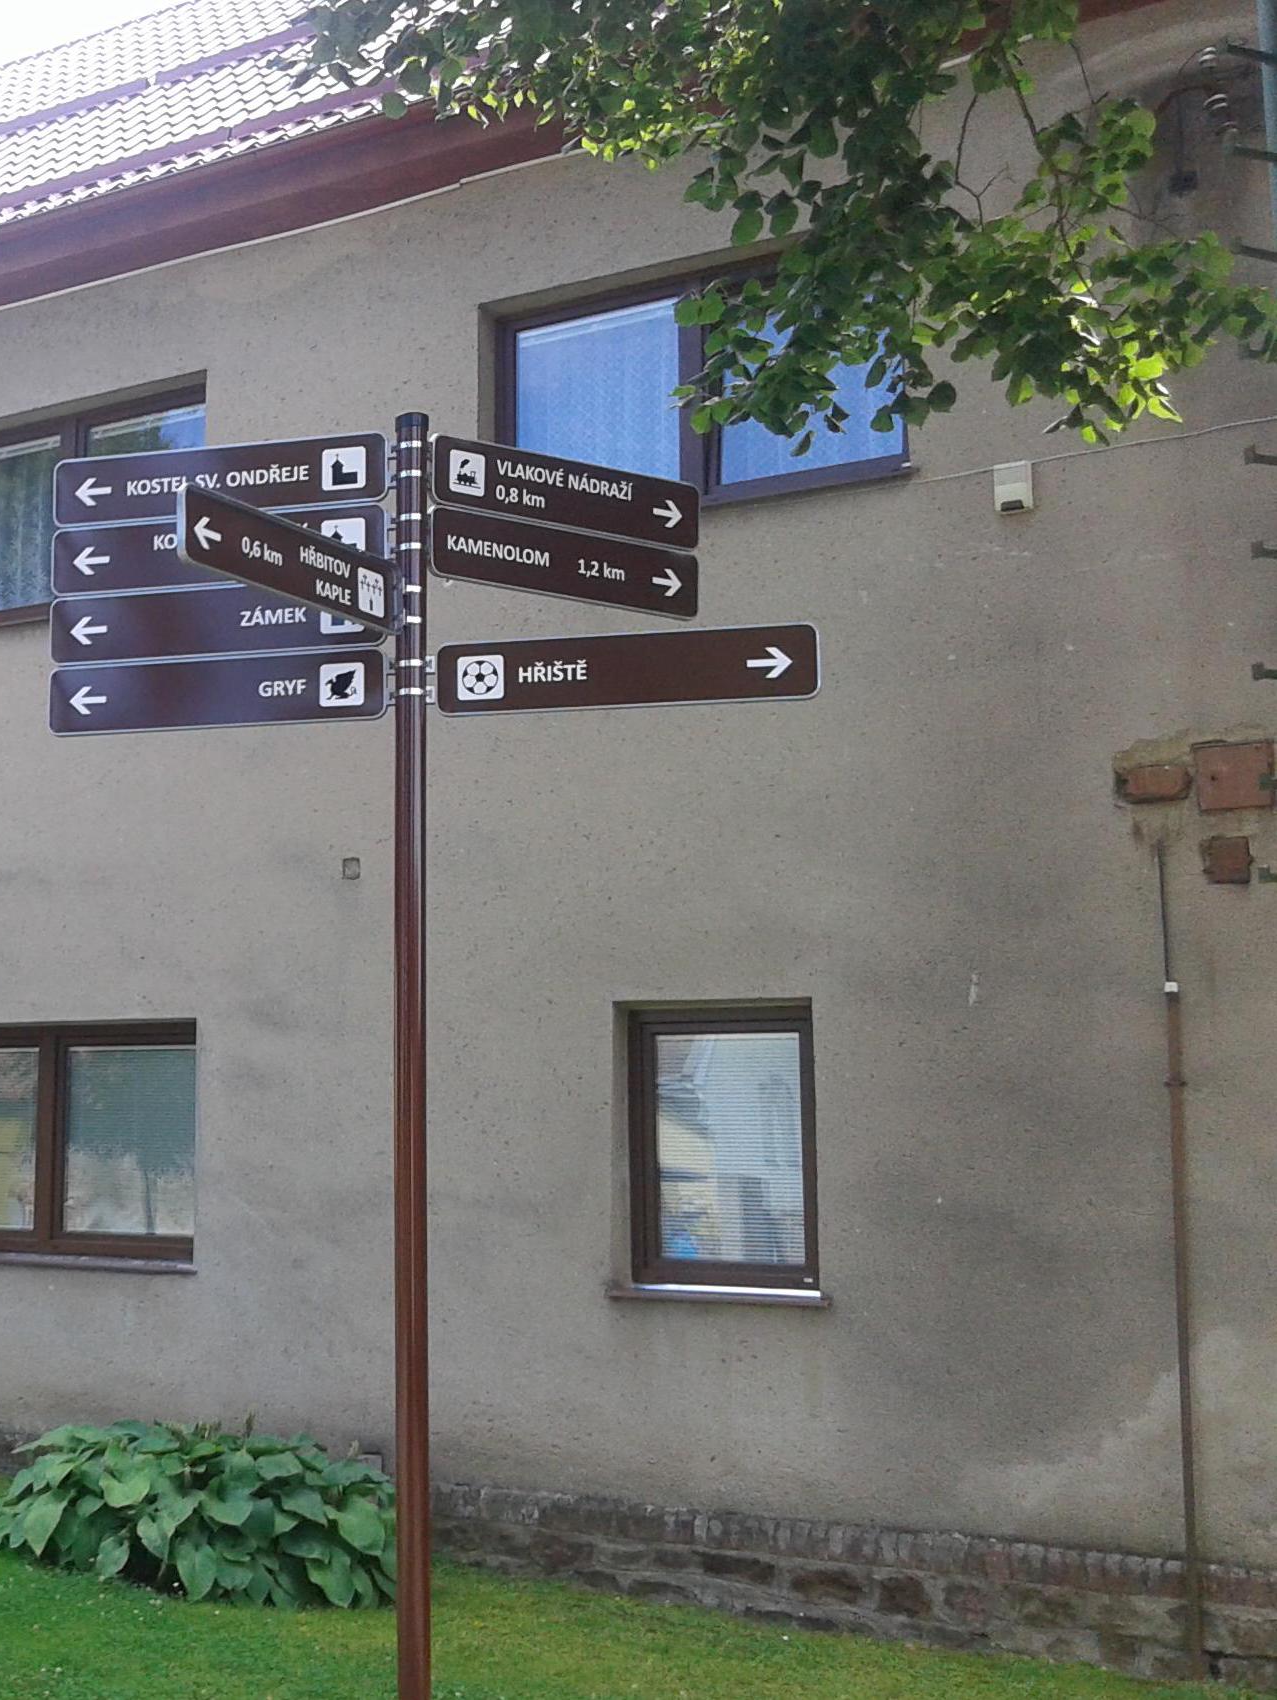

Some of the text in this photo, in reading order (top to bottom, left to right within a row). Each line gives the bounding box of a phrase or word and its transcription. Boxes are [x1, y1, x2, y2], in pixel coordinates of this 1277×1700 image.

[195, 473, 221, 489] SV.
[226, 464, 310, 488] ONDŘEJE
[497, 459, 633, 501] VLAKOVÉ NÁDRAŽÍ
[496, 484, 545, 509] 0,8 km
[241, 536, 283, 567] 0,6 km
[299, 545, 351, 579] HŘBITOV
[447, 534, 625, 581] KAMENOLOM 1,2 km
[316, 578, 352, 606] KAPLE
[240, 606, 307, 627] ZÁMEK
[518, 660, 588, 684] HŘIŠTĚ
[258, 678, 307, 697] GRYF
